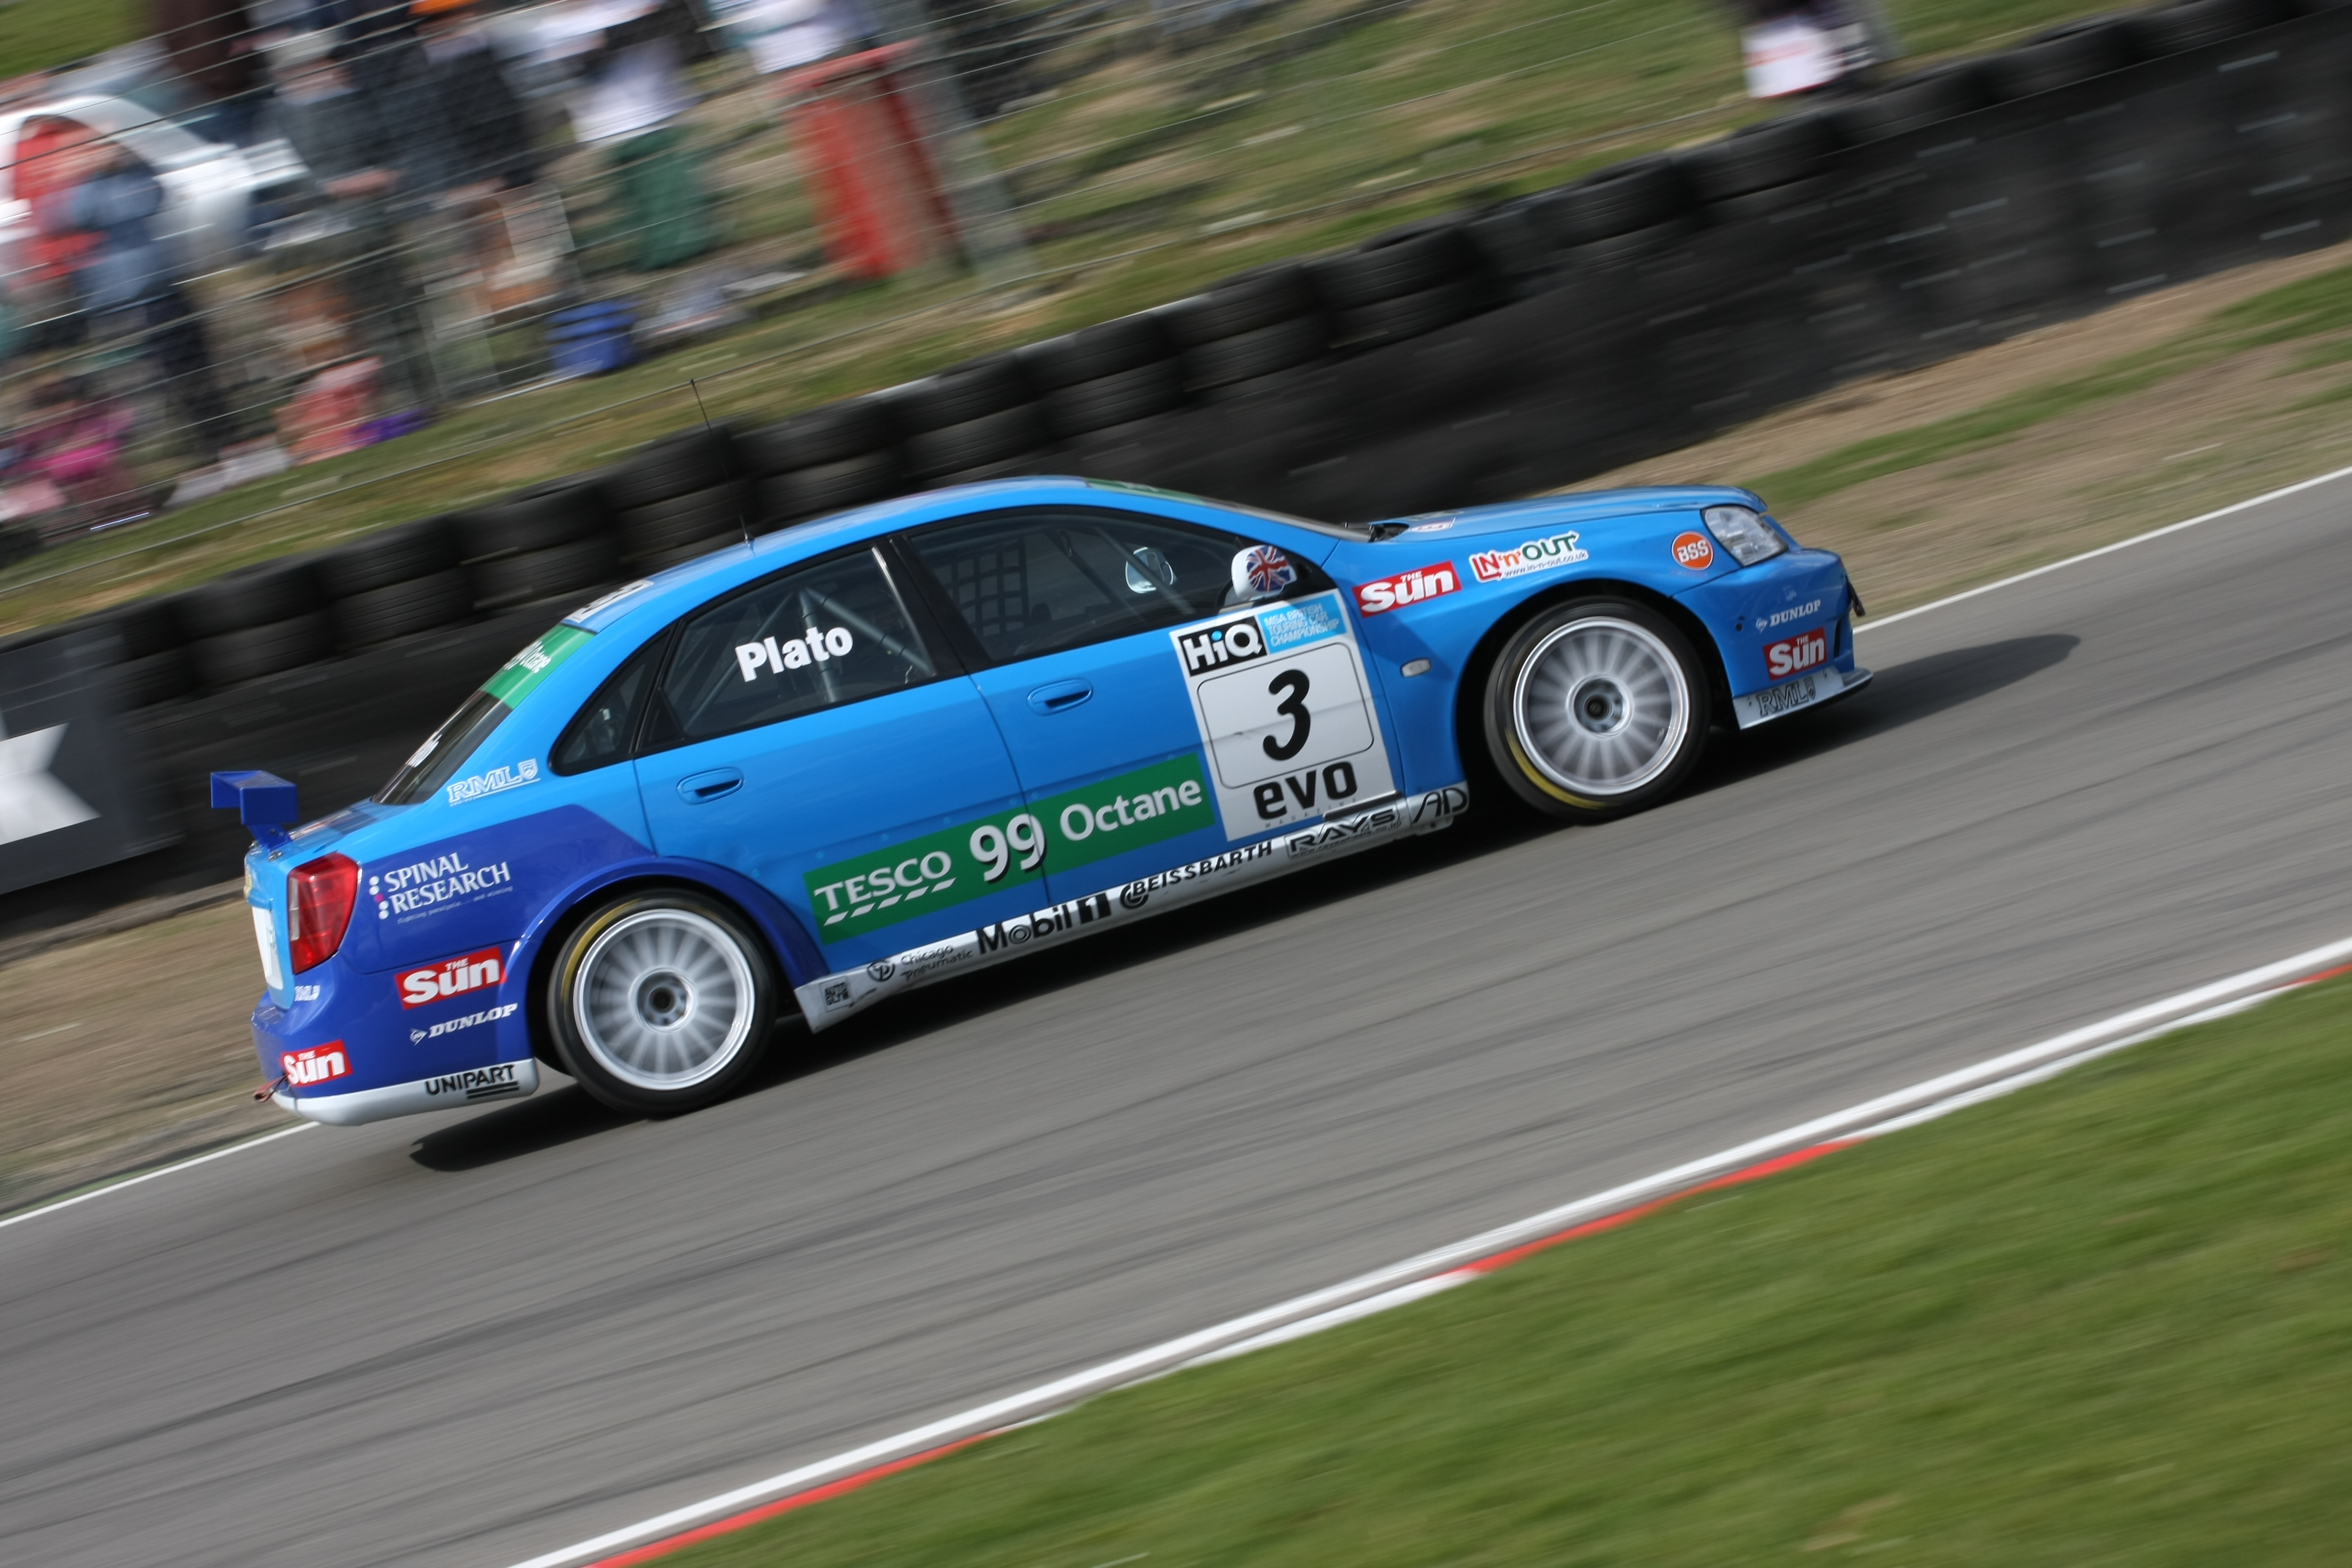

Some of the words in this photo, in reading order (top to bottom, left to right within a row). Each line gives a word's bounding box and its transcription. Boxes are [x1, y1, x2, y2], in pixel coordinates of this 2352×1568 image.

[1677, 539, 1709, 563] BSS
[1361, 570, 1454, 613] Sun
[1400, 570, 1422, 583] THE
[1268, 617, 1308, 635] TOURING
[1308, 611, 1328, 625] CAR
[1769, 599, 1821, 627] DUNLOP
[1183, 624, 1263, 670] HiQ
[1271, 618, 1339, 647] CHAMPIONSHIP
[1797, 635, 1809, 645] THE
[735, 626, 853, 682] Plato
[1769, 638, 1824, 676] Sun
[1263, 669, 1311, 761] 3
[1756, 681, 1809, 717] RML
[446, 765, 524, 803] RML
[1253, 761, 1357, 820] evo
[814, 851, 952, 911] TESCO
[969, 814, 1048, 883] 99
[1060, 779, 1203, 841] Octane
[1290, 808, 1396, 852] RAYS
[384, 852, 469, 893] SPINAL
[1131, 841, 1272, 897] BEISSBARTH
[388, 861, 511, 915] RESEARCH
[976, 903, 1073, 954] Mobil
[445, 958, 469, 971] THE
[900, 949, 974, 981] Pneumatic
[901, 945, 953, 965] Chicago
[403, 959, 500, 1004] Sun
[428, 1002, 518, 1039] DUNLOP
[284, 1052, 345, 1084] Sun
[298, 1050, 316, 1061] THE
[425, 1065, 515, 1095] UNIPART
